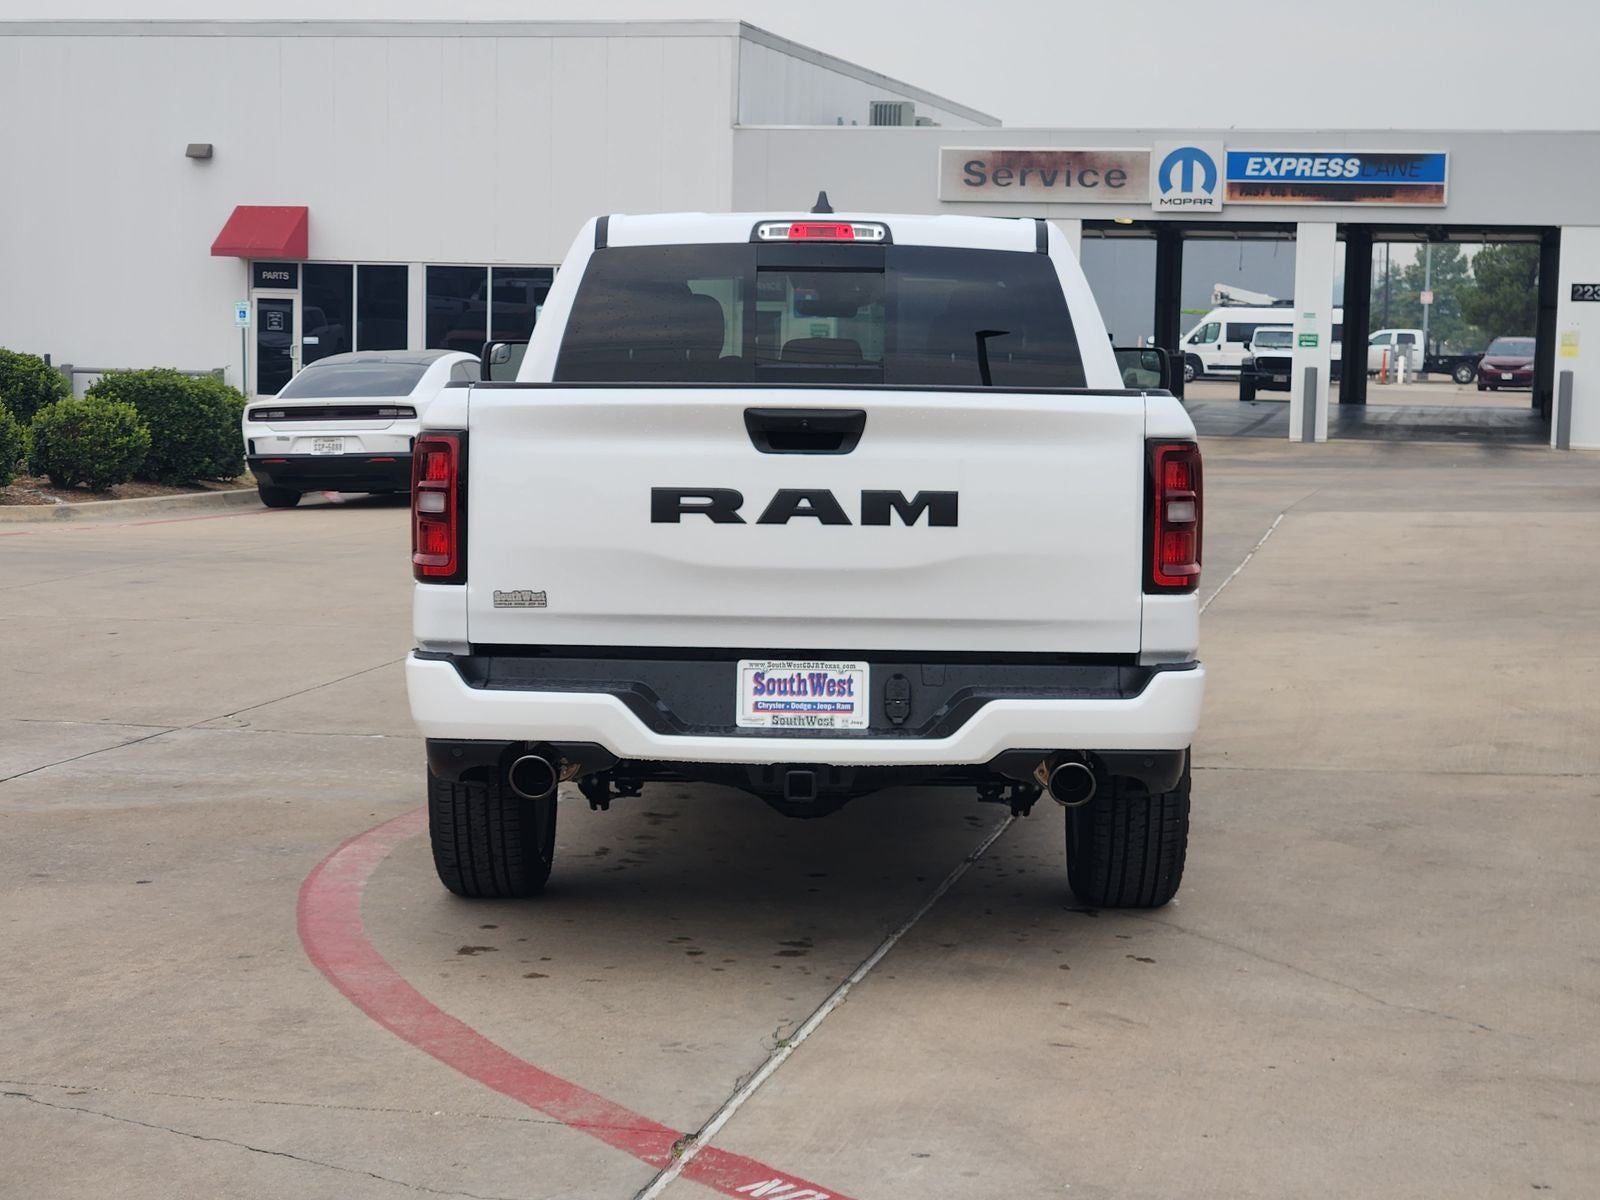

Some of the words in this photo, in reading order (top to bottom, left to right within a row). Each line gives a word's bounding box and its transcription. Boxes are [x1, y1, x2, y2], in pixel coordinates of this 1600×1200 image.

[963, 160, 1127, 188] Service
[1245, 157, 1361, 178] EXPRESS
[1361, 159, 1423, 178] LANE
[1159, 198, 1214, 206] MOPAR
[262, 271, 290, 280] PARTS
[650, 487, 958, 527] RAM
[752, 671, 854, 697] SouthWest
[757, 702, 785, 711] Chrysler
[791, 702, 812, 711] Dodge
[816, 703, 832, 711] Jeep
[836, 703, 851, 711] Ram
[771, 715, 835, 727] SouthWest
